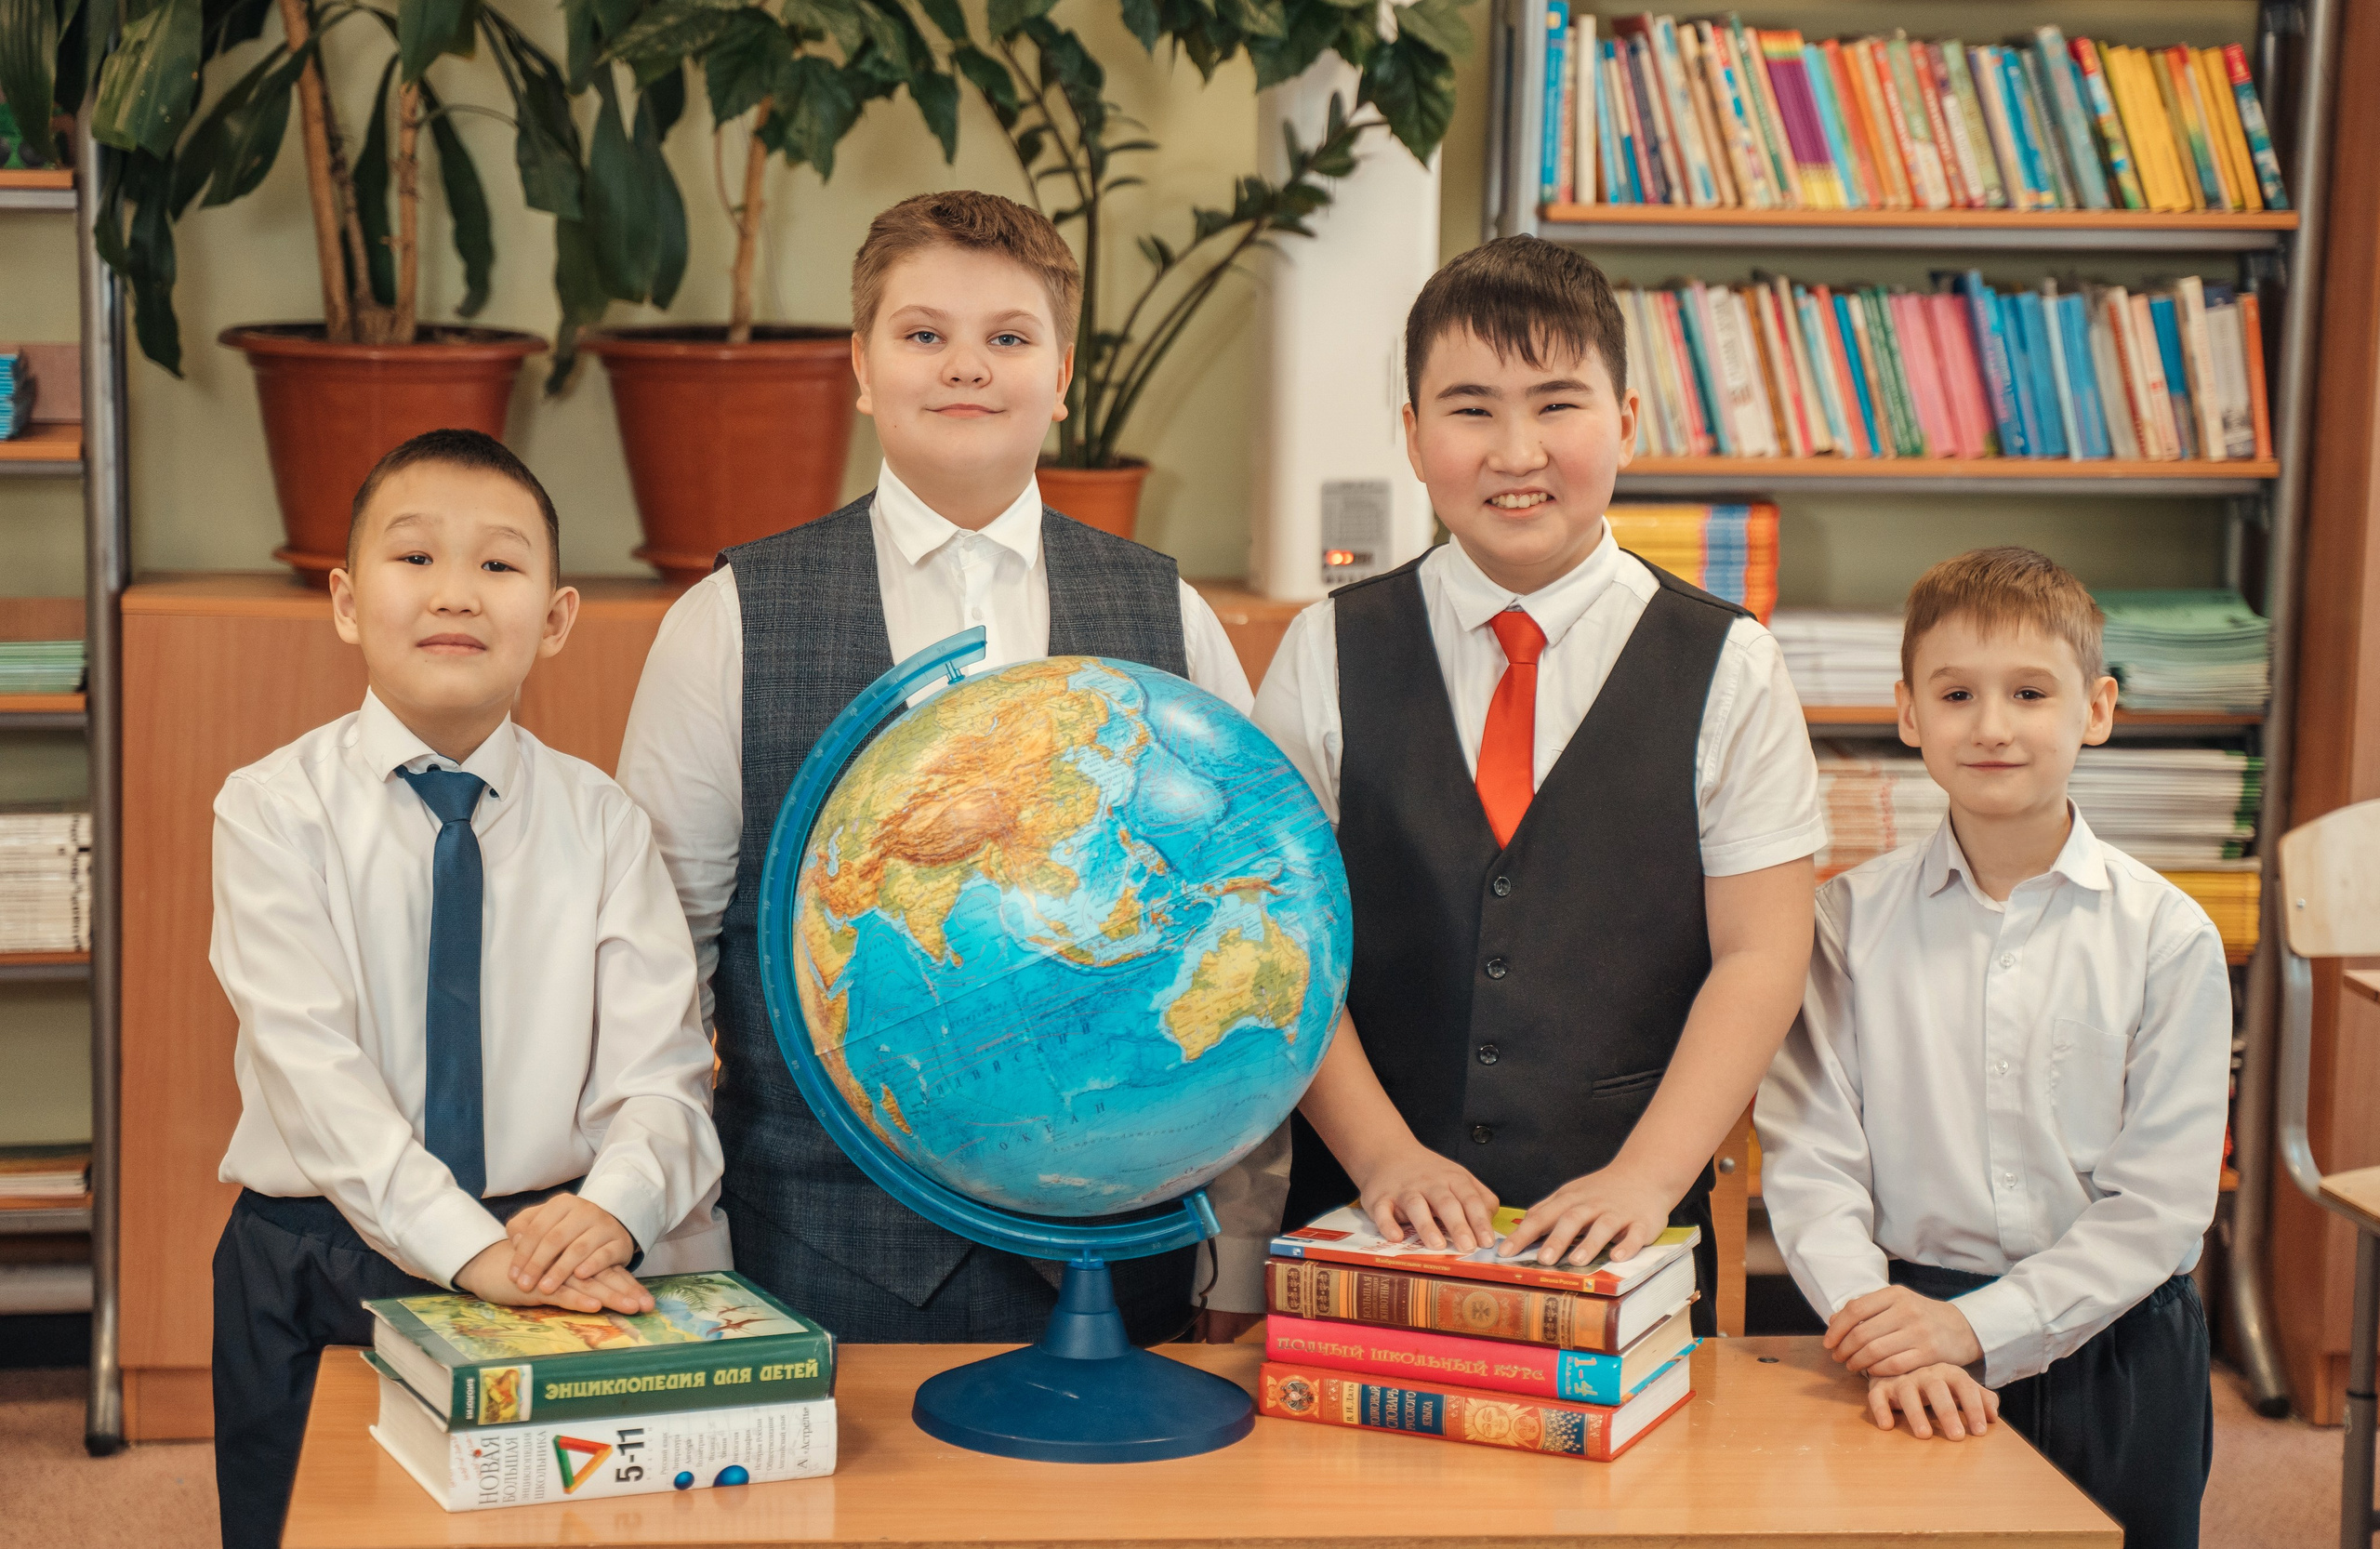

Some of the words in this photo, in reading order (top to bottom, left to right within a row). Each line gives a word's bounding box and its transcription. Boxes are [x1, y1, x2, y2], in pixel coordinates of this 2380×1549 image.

[998, 1101, 1106, 1151] ОКЕАН
[1363, 1276, 1373, 1319] БОЛЬШАЯ
[1380, 1278, 1390, 1321] ЖИВОТНЫХ
[544, 1370, 707, 1400] ЭНЦИКЛОПЕДИЯ
[713, 1367, 752, 1386] ДЛЯ
[759, 1358, 819, 1383] ДЕТЕЙ
[1276, 1336, 1366, 1360] ПОЛНЫЙ
[1369, 1347, 1489, 1377] ШКОЛЬНЫЙ
[1493, 1364, 1546, 1382] КУРС
[1574, 1357, 1598, 1397] 1-4
[465, 1378, 475, 1420] БИОЛОГИЯ
[1346, 1384, 1355, 1405] Даль
[1368, 1385, 1382, 1427] ТОЛКОВЫЙ
[1385, 1387, 1399, 1429] СЛОВАРЬ
[1405, 1390, 1417, 1431] РУССКОГО
[1421, 1400, 1434, 1427] ЯЗЫКА
[479, 1435, 500, 1505] НОВАЯ
[503, 1436, 518, 1503] БОЛЬШАЯ
[522, 1432, 532, 1503] ЭНЦИКЛОПЕДИЯ
[535, 1430, 547, 1501] ШКОЛЬНИКА
[615, 1427, 645, 1483] 5-11
